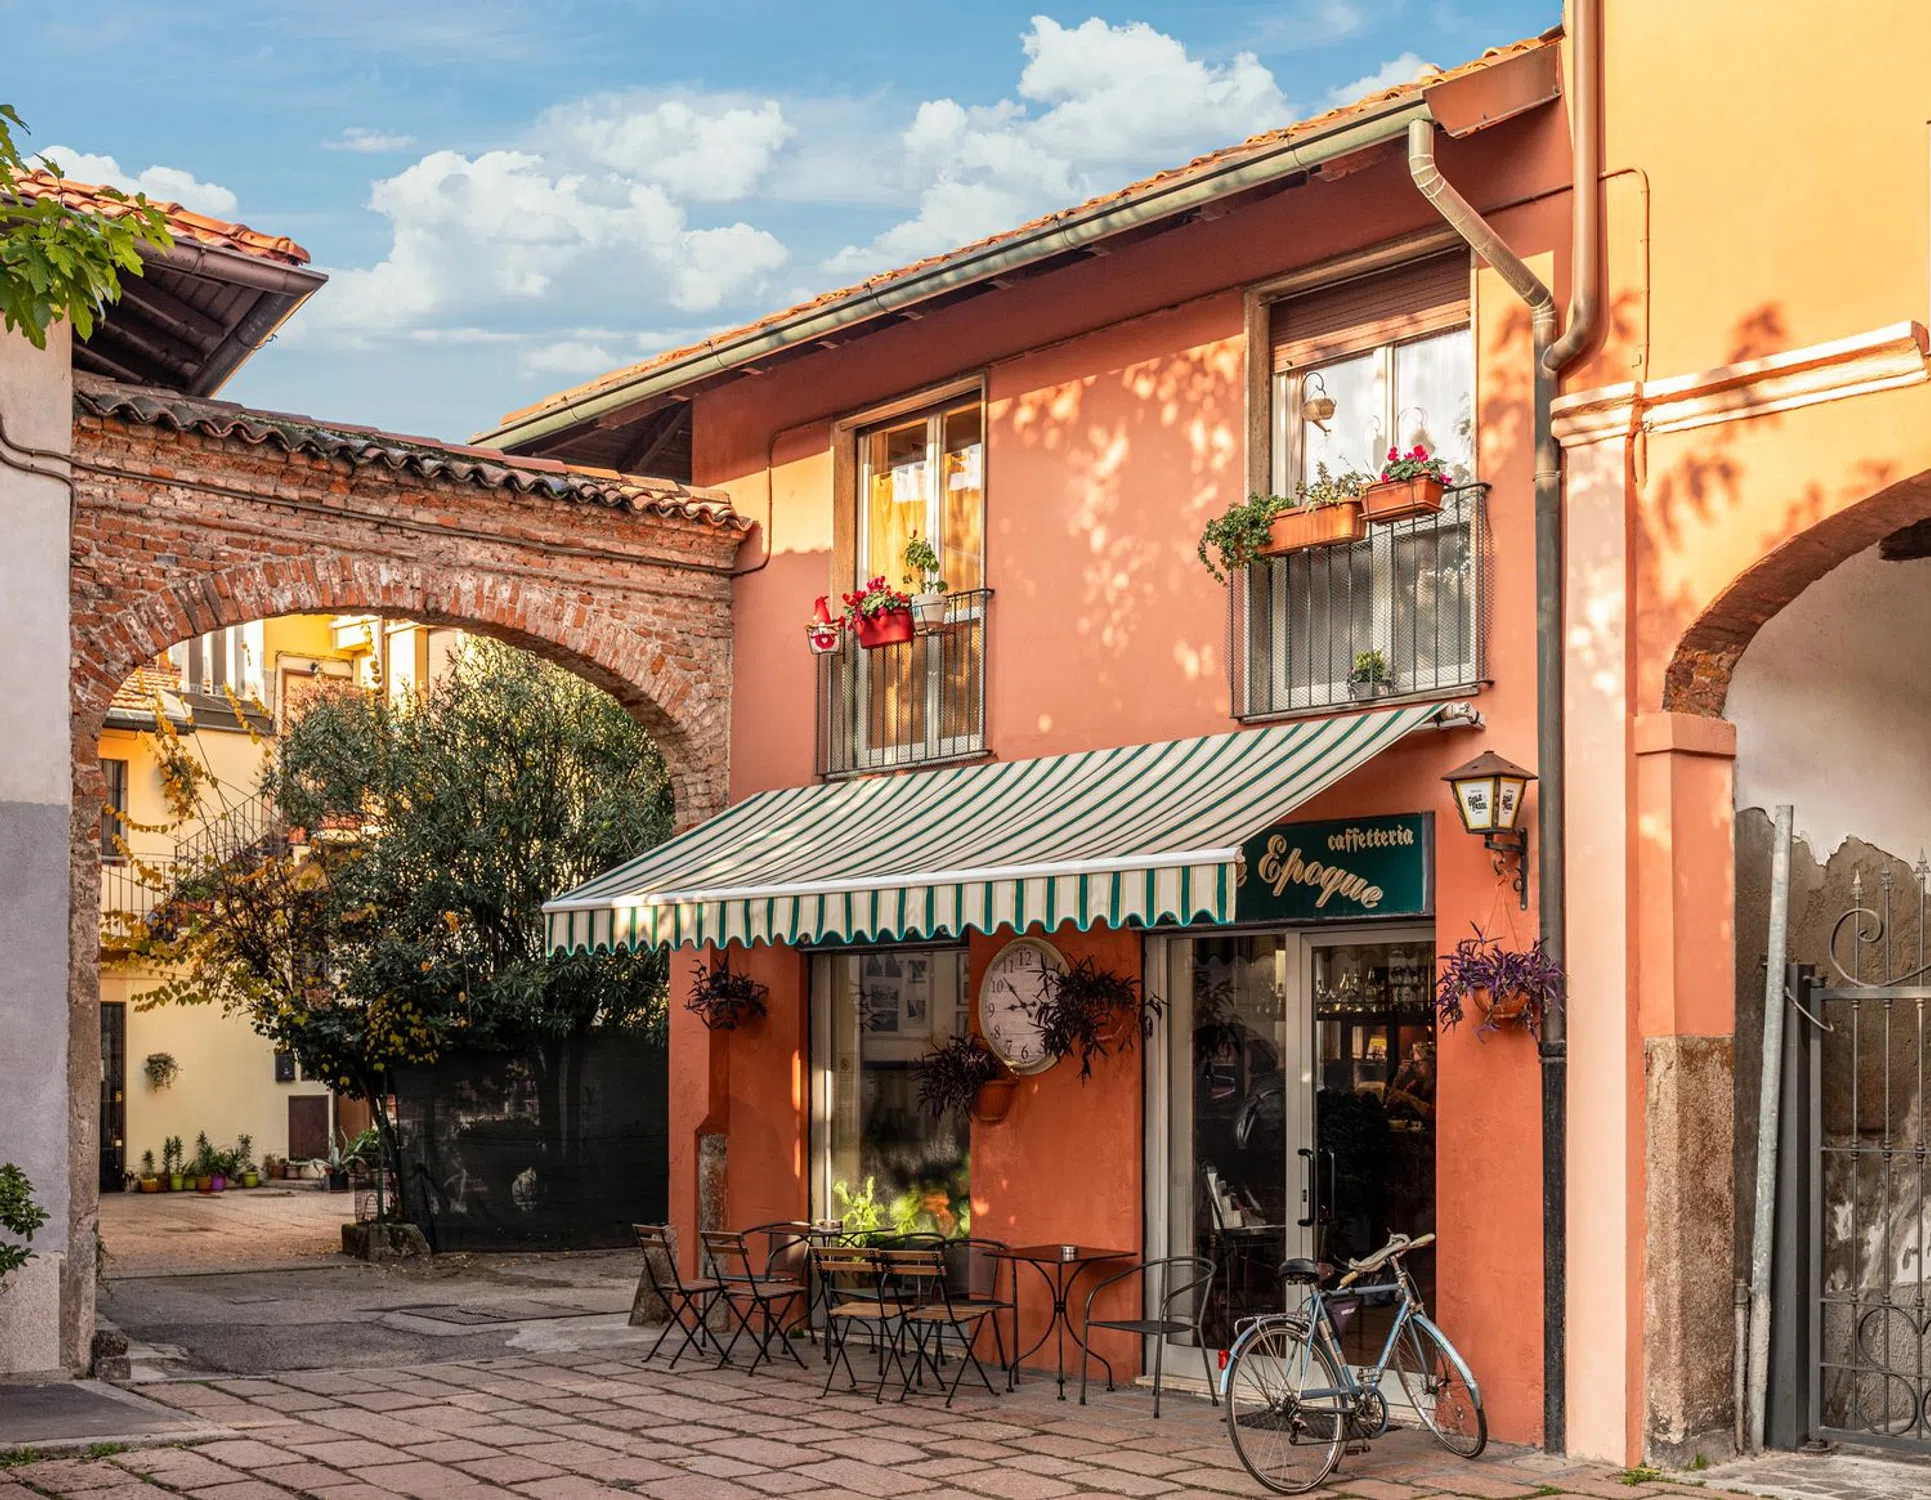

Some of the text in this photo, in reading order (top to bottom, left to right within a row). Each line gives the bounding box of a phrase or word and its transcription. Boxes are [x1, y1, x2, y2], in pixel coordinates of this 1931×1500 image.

[1328, 825, 1414, 852] caffetteria
[1258, 834, 1384, 908] Epoque
[1003, 957, 1014, 974] 11
[1019, 951, 1032, 966] 12
[991, 979, 1004, 993] 10
[988, 1003, 995, 1018] 9
[993, 1025, 1001, 1040] 8
[1005, 1040, 1013, 1056] 7
[1021, 1043, 1029, 1060] 6
